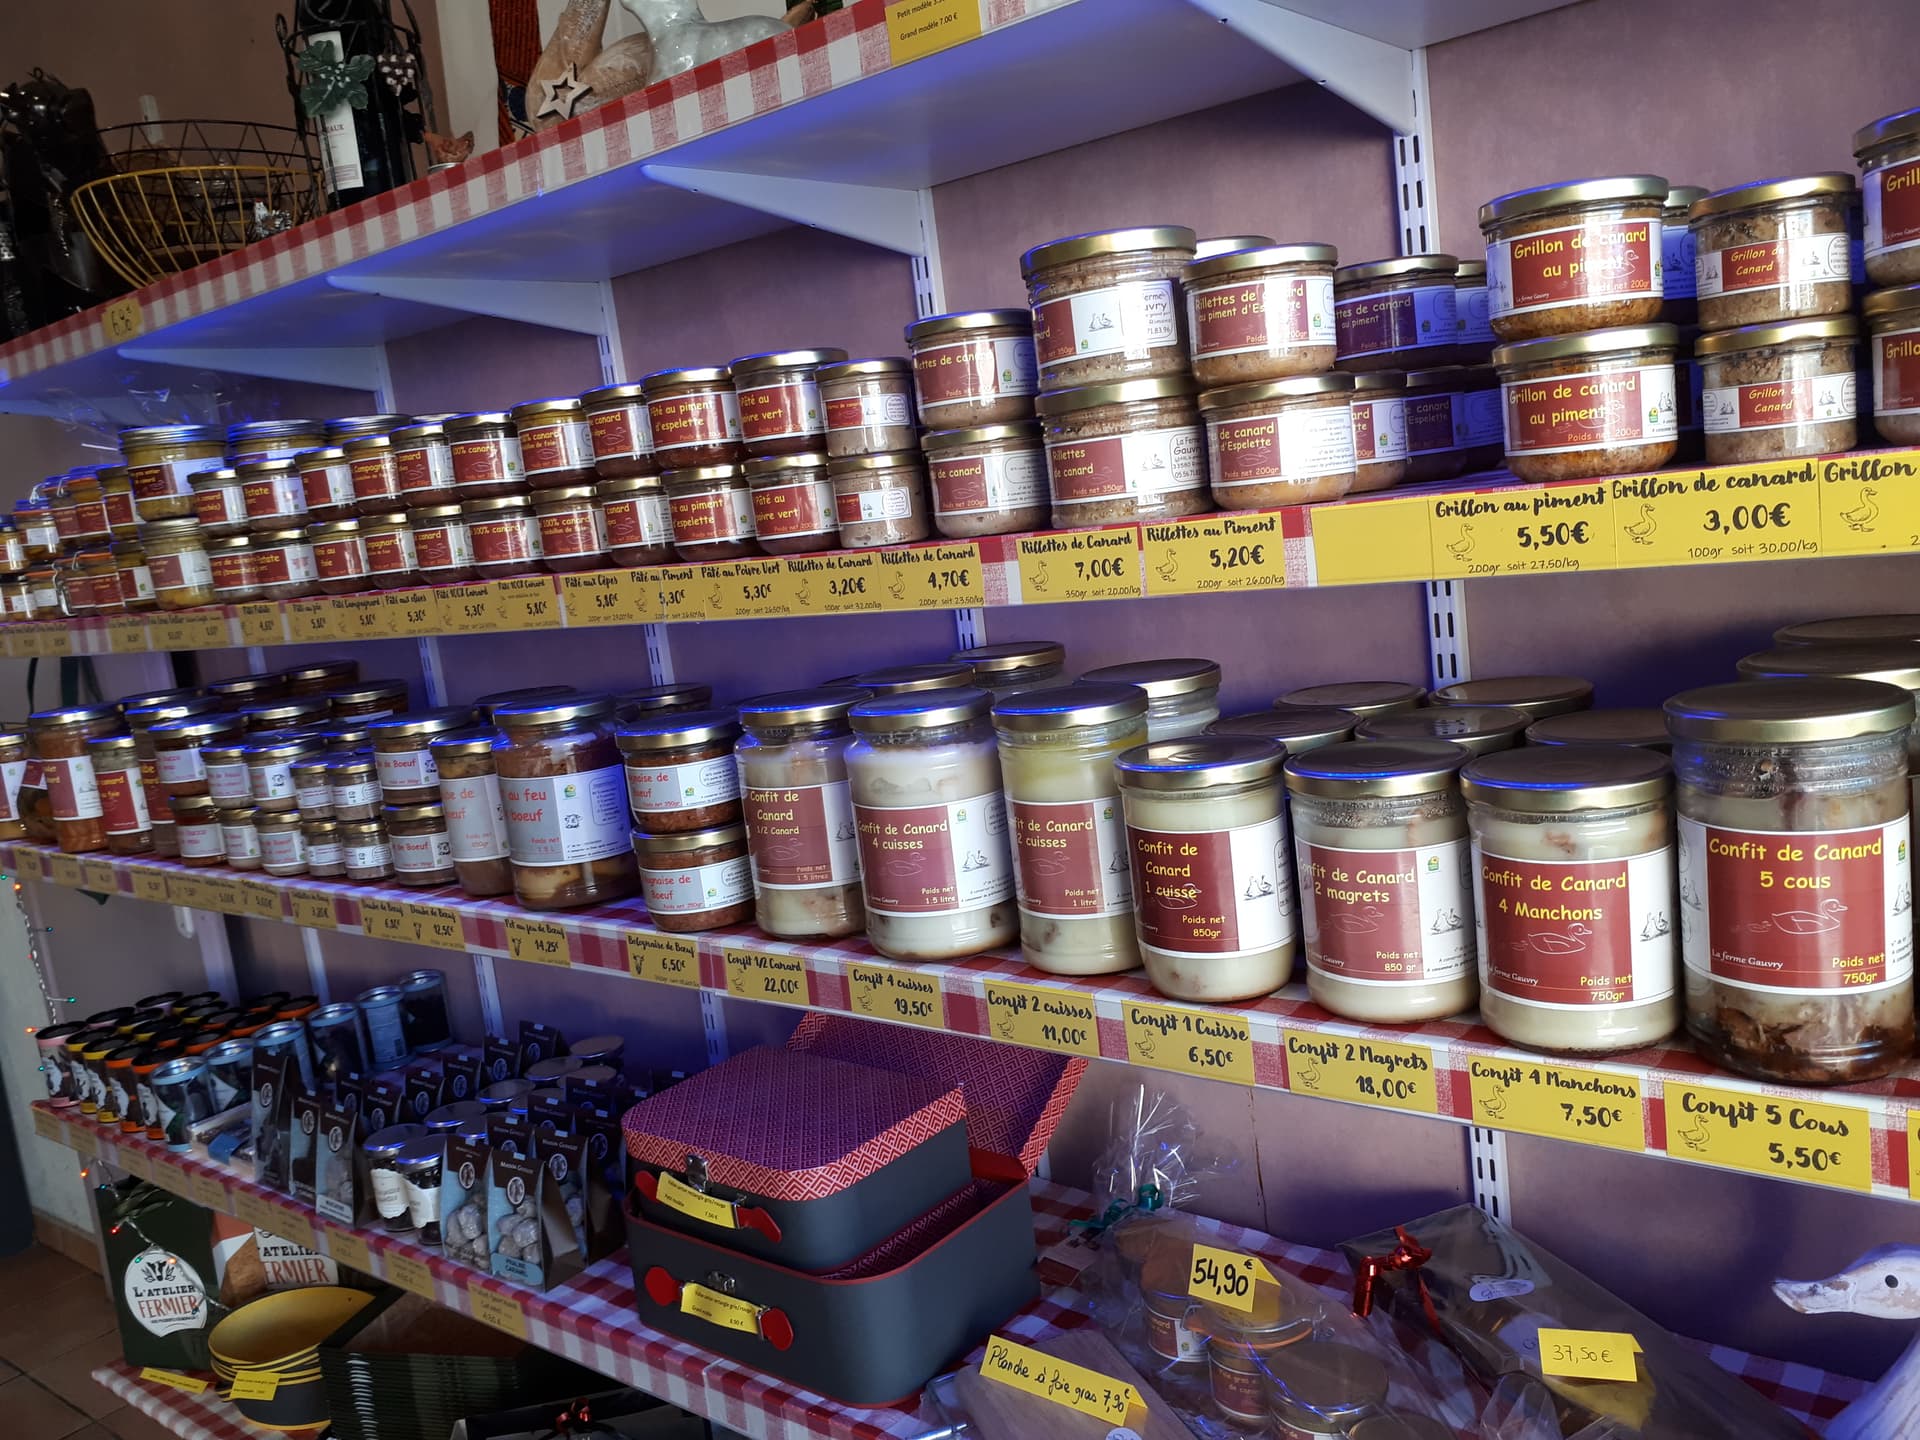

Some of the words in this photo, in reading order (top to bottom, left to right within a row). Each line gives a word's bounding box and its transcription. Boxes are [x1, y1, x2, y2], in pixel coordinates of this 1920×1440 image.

[900, 29, 918, 41] Grand
[918, 20, 939, 34] modèle
[1513, 239, 1564, 259] Grillon
[1599, 226, 1648, 246] canard
[1731, 248, 1766, 262] Grillon
[1736, 261, 1774, 276] Canard
[758, 395, 770, 404] au
[1509, 387, 1547, 406] Grillon
[1552, 383, 1573, 400] de
[1580, 375, 1637, 397] canard
[1748, 386, 1787, 400] Grillon
[665, 405, 677, 415] au
[679, 400, 714, 415] piment
[762, 408, 784, 421] vert
[1529, 410, 1546, 425] au
[1551, 405, 1607, 427] piment
[1753, 399, 1794, 414] Canard
[656, 416, 705, 432] d'espelette
[937, 467, 947, 478] de
[948, 463, 983, 478] canard
[1822, 457, 1919, 484] Grillon
[1612, 477, 1687, 501] Grillon
[1693, 472, 1720, 494] de
[1726, 461, 1818, 489] canard
[679, 503, 689, 513] au
[691, 500, 724, 513] piment
[774, 494, 786, 503] au
[1435, 499, 1500, 519] Grillon
[1503, 499, 1530, 514] au
[1532, 487, 1607, 516] piment
[1703, 501, 1793, 534] 3,00€
[1146, 524, 1200, 543] Rillettes
[1202, 526, 1222, 538] au
[1223, 516, 1277, 536] Piment
[1516, 520, 1591, 550] 5,50€
[788, 559, 824, 573] Rillettes
[826, 559, 836, 569] de
[837, 555, 874, 570] Canard
[880, 549, 921, 565] Rillettes
[923, 549, 934, 562] de
[935, 545, 976, 561] Canard
[1209, 544, 1266, 570] 5,20€
[630, 571, 649, 584] Pâté
[649, 572, 661, 583] au
[662, 568, 694, 582] Piment
[701, 564, 722, 579] Pâté
[722, 567, 736, 577] au
[736, 563, 762, 578] Poivre
[762, 563, 782, 576] Vert
[1074, 557, 1126, 581] 7,00€
[1467, 562, 1501, 576] 200gr
[1506, 560, 1528, 572] soit
[1529, 557, 1581, 573] 27.50/kg
[565, 576, 582, 588] Pâté
[582, 577, 597, 587] aux
[598, 574, 619, 588] Cèpes
[828, 576, 867, 595] 3,20€
[927, 569, 971, 590] 4,70€
[658, 589, 686, 605] 5,30€
[742, 582, 773, 601] 5,30€
[507, 792, 520, 801] au
[523, 789, 547, 802] feu
[750, 789, 779, 804] Confit
[783, 791, 800, 804] de
[756, 808, 794, 822] Canard
[756, 825, 769, 835] 1/2
[769, 825, 801, 836] Canard
[1027, 819, 1042, 833] de
[1045, 817, 1094, 833] Canard
[871, 838, 880, 849] 4
[882, 837, 925, 850] cuisses
[1137, 838, 1174, 857] Confit
[1179, 842, 1199, 857] de
[1708, 837, 1768, 862] Confit
[1776, 843, 1805, 862] de
[1813, 837, 1883, 862] Canard
[1145, 860, 1192, 878] Canard
[1331, 867, 1350, 882] de
[1355, 867, 1416, 885] Canard
[1481, 865, 1523, 889] Confit
[1530, 874, 1553, 891] de
[1560, 871, 1627, 892] Canard
[1759, 870, 1774, 889] 5
[1783, 873, 1832, 890] cous
[1145, 880, 1151, 894] 1
[1156, 884, 1198, 900] cuisse
[1314, 881, 1322, 896] 2
[1326, 885, 1391, 905] magrets
[1499, 898, 1509, 914] 4
[1514, 900, 1604, 921] Manchons
[505, 918, 516, 929] Pot
[526, 924, 537, 936] feu
[537, 926, 546, 934] de
[1192, 928, 1222, 940] 850gr
[533, 938, 560, 954] 14,25€
[627, 934, 665, 951] Bolognaise
[666, 942, 674, 951] de
[661, 957, 687, 973] 6,50€
[727, 951, 753, 972] Confit
[753, 956, 769, 969] 1/2
[768, 959, 803, 973] Canard
[1831, 955, 1865, 970] Poids
[1868, 951, 1886, 966] net
[763, 976, 800, 995] 22,00€
[853, 968, 885, 990] Confit
[886, 972, 895, 987] 4
[896, 977, 934, 995] cuisses
[1580, 975, 1611, 987] Poids
[1614, 974, 1633, 985] net
[1843, 971, 1879, 986] 750gr
[1590, 989, 1625, 1003] 750gr
[894, 996, 934, 1017] 19,50€
[1041, 1023, 1088, 1046] 11,00€
[1131, 1008, 1179, 1036] Confit
[1182, 1015, 1192, 1032] 1
[1195, 1016, 1250, 1042] Cuisse
[1188, 1045, 1234, 1068] 6,50€
[1288, 1036, 1341, 1060] Confit
[1345, 1043, 1356, 1062] 2
[1359, 1045, 1429, 1073] Magrets
[1355, 1074, 1418, 1100] 18,00€
[1470, 1061, 1524, 1086] Confit
[1528, 1068, 1542, 1085] 4
[1546, 1071, 1638, 1099] Manchons
[1560, 1102, 1624, 1128] 7,50€
[1682, 1091, 1759, 1129] Confit
[1765, 1104, 1782, 1126] 5
[1789, 1107, 1850, 1138] Cous
[1767, 1142, 1842, 1172] 5,50€
[1192, 1257, 1255, 1297] 54,90€
[133, 1283, 198, 1299] L'ATELIER
[137, 1294, 200, 1320] FERMIER
[1552, 1343, 1614, 1365] 37,50€
[988, 1343, 1030, 1379] Planche
[1034, 1367, 1047, 1385] à
[1048, 1368, 1071, 1396] foie
[1072, 1386, 1098, 1406] gras
[1103, 1387, 1131, 1414] 7,90€
